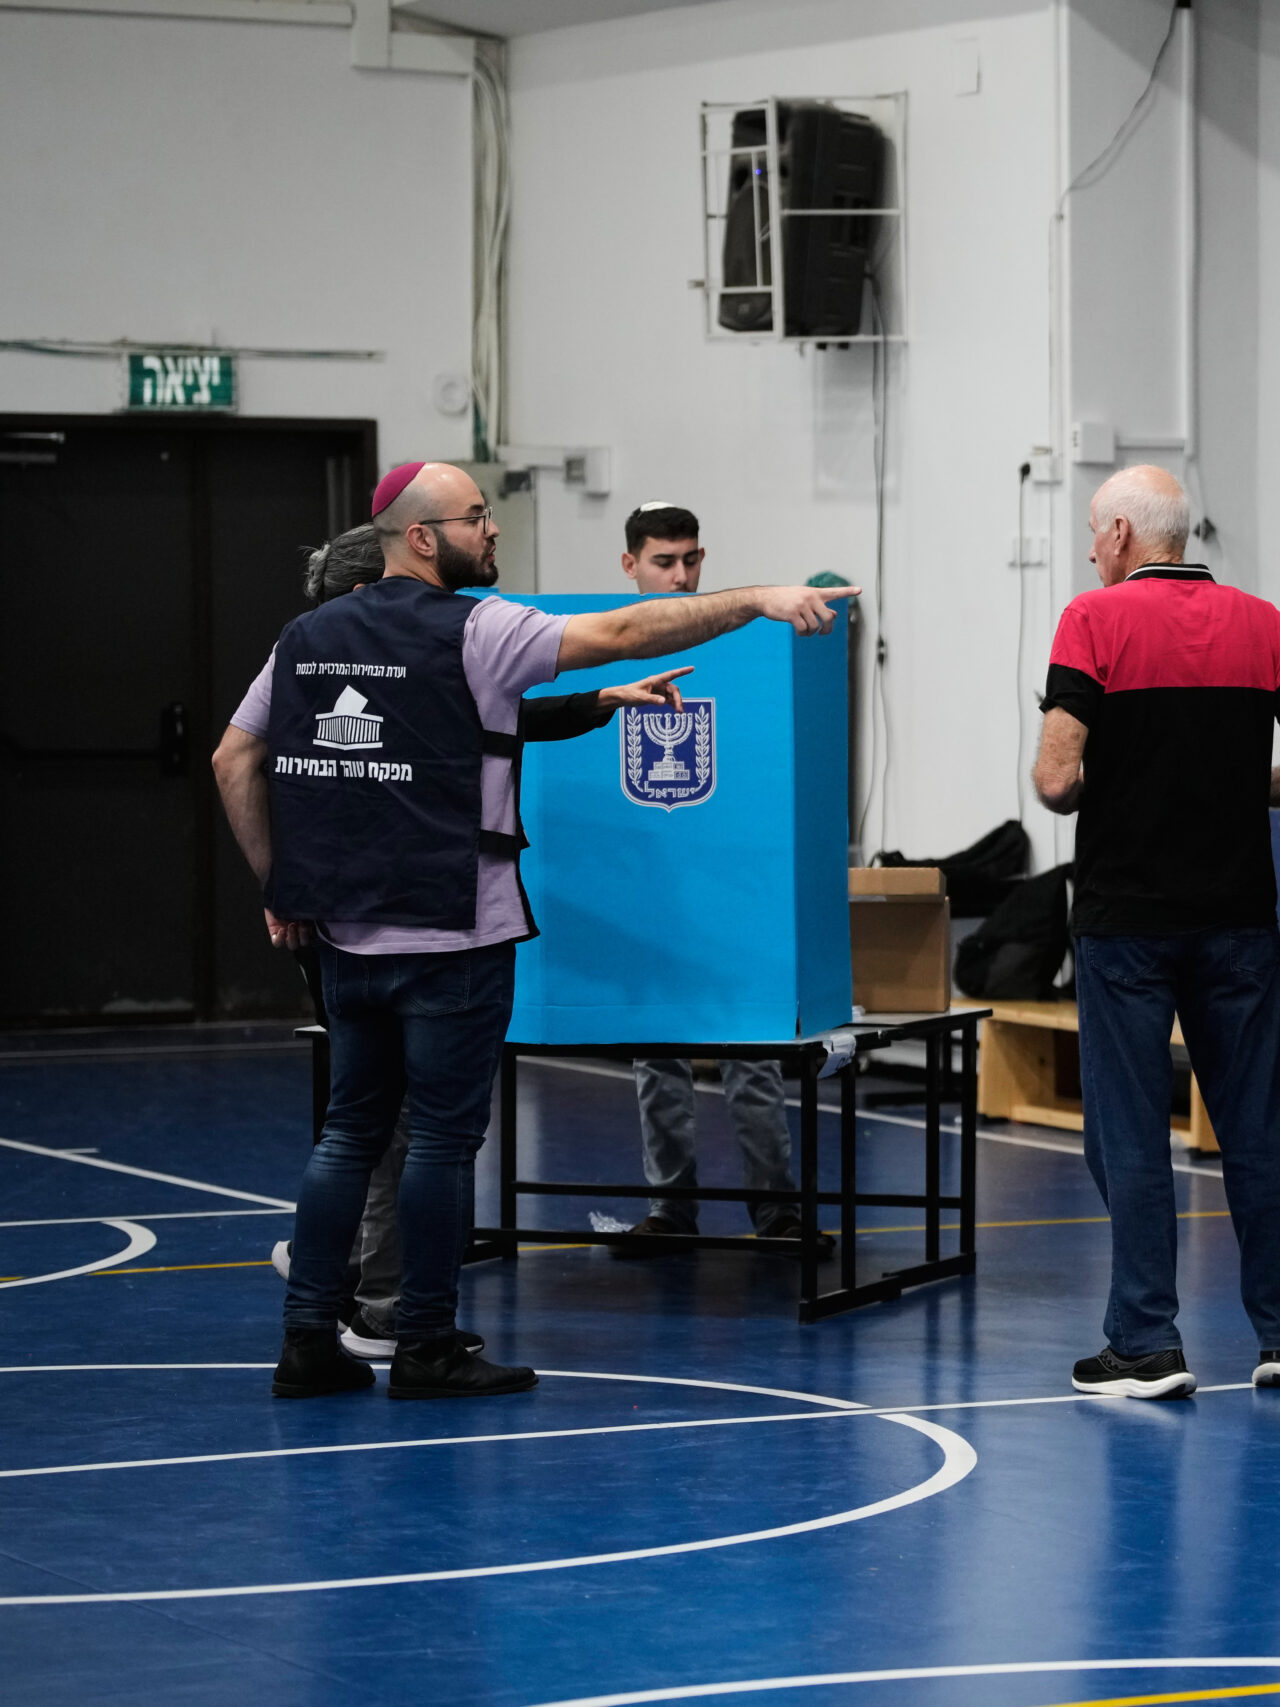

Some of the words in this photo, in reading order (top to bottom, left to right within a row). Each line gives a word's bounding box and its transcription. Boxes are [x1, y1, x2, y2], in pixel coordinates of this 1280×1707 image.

[143, 356, 220, 404] יציאה
[296, 661, 317, 675] לכנסת
[318, 662, 350, 675] המרכזית
[352, 663, 385, 677] הבחירות
[386, 665, 406, 678] ועדת
[275, 756, 337, 777] הבחירות
[340, 759, 365, 778] טוהר
[368, 761, 413, 782] מפקח
[643, 780, 696, 799] ישראל
